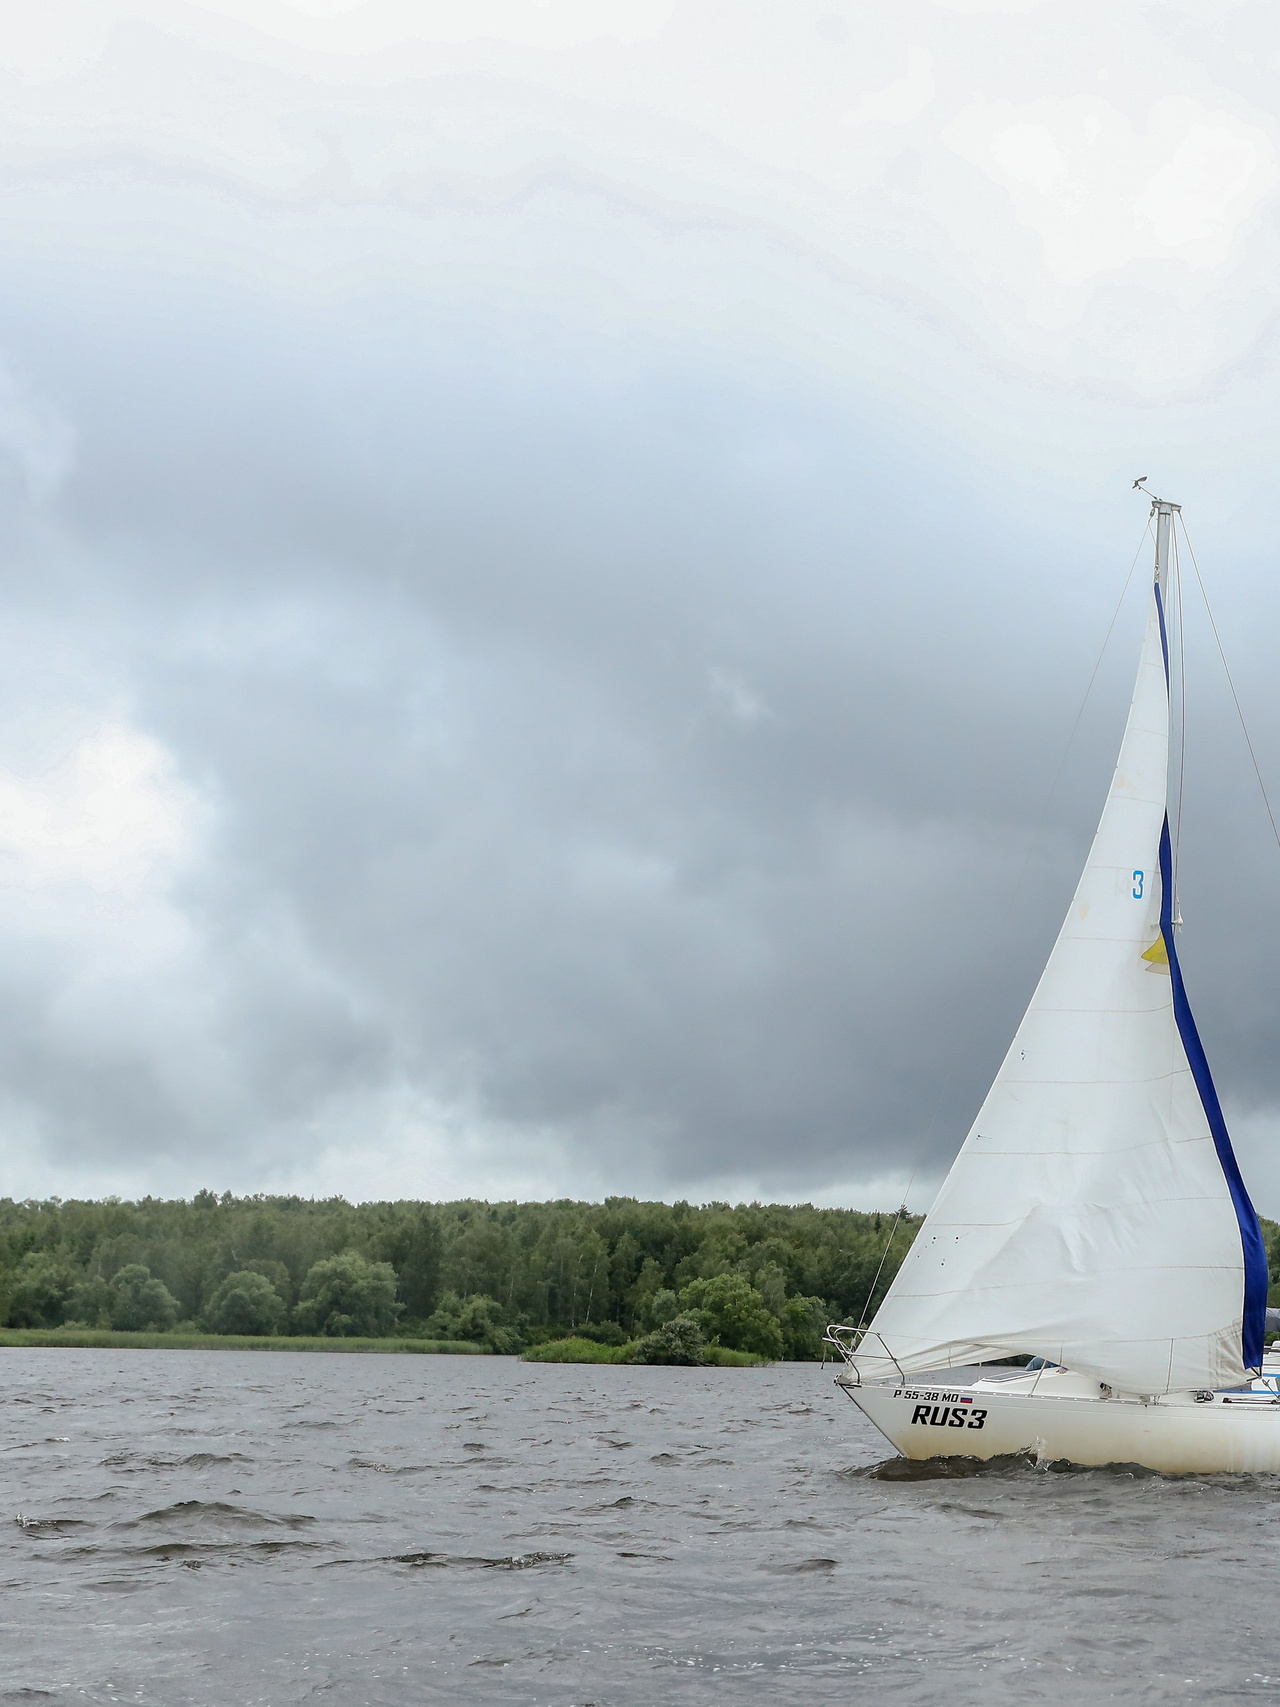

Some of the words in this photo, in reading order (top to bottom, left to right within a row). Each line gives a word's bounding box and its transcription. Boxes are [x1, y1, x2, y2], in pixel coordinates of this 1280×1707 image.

[1132, 869, 1145, 899] 3
[903, 1390, 940, 1402] 55-38
[911, 1404, 988, 1430] RUS3
